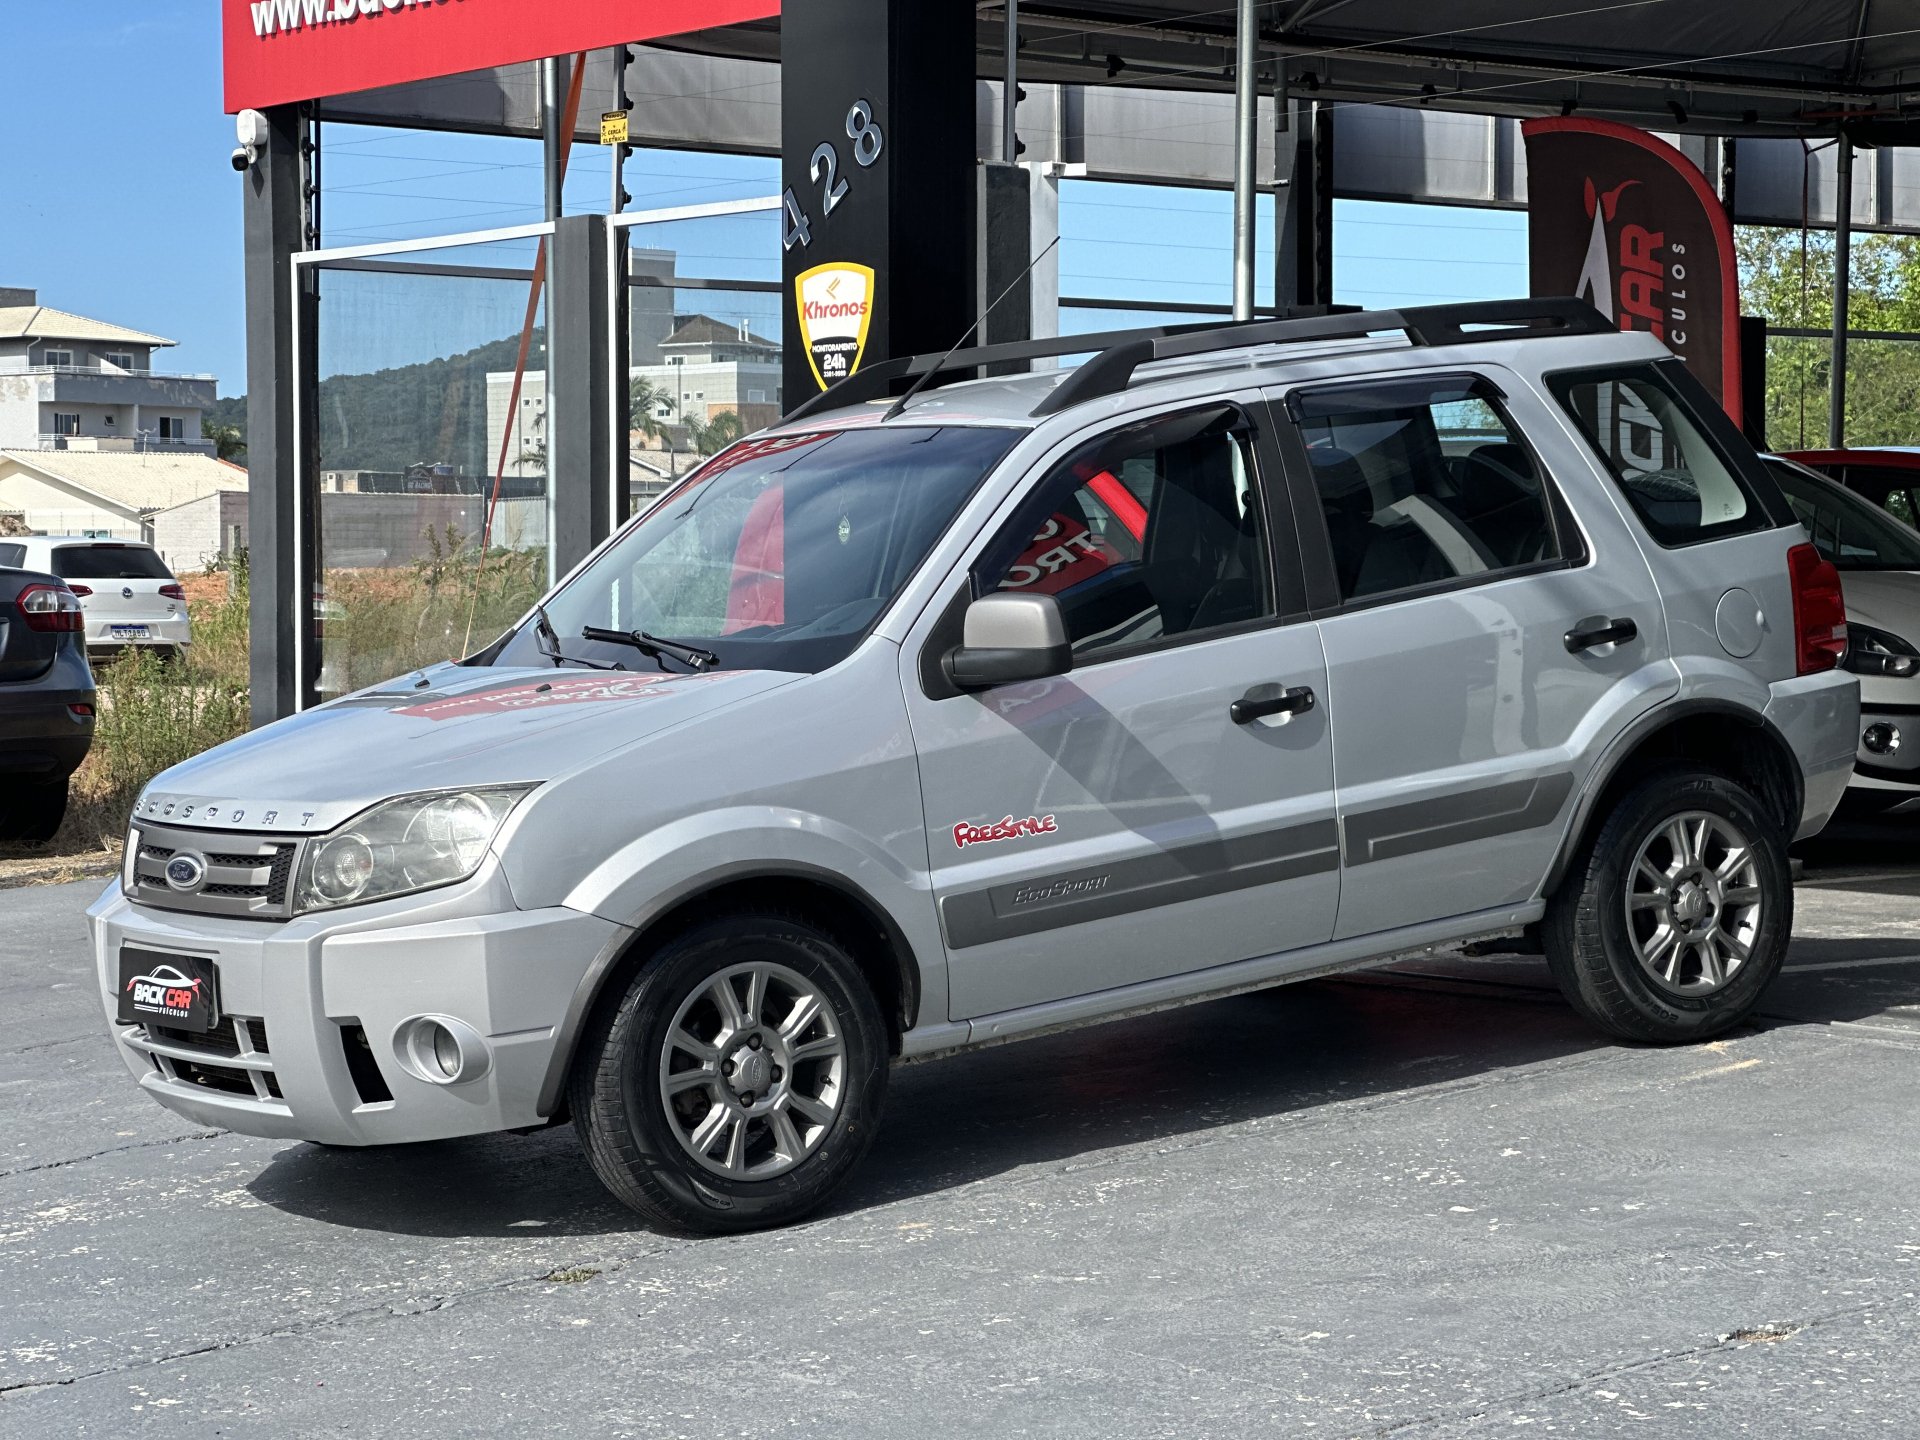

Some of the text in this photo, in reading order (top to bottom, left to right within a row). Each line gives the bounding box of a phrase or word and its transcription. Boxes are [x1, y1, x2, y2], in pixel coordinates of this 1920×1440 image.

[802, 301, 868, 320] Khronos
[812, 342, 858, 353] MONITORAMENTO
[823, 353, 846, 370] 24h
[133, 983, 192, 1009] BACK CAR
